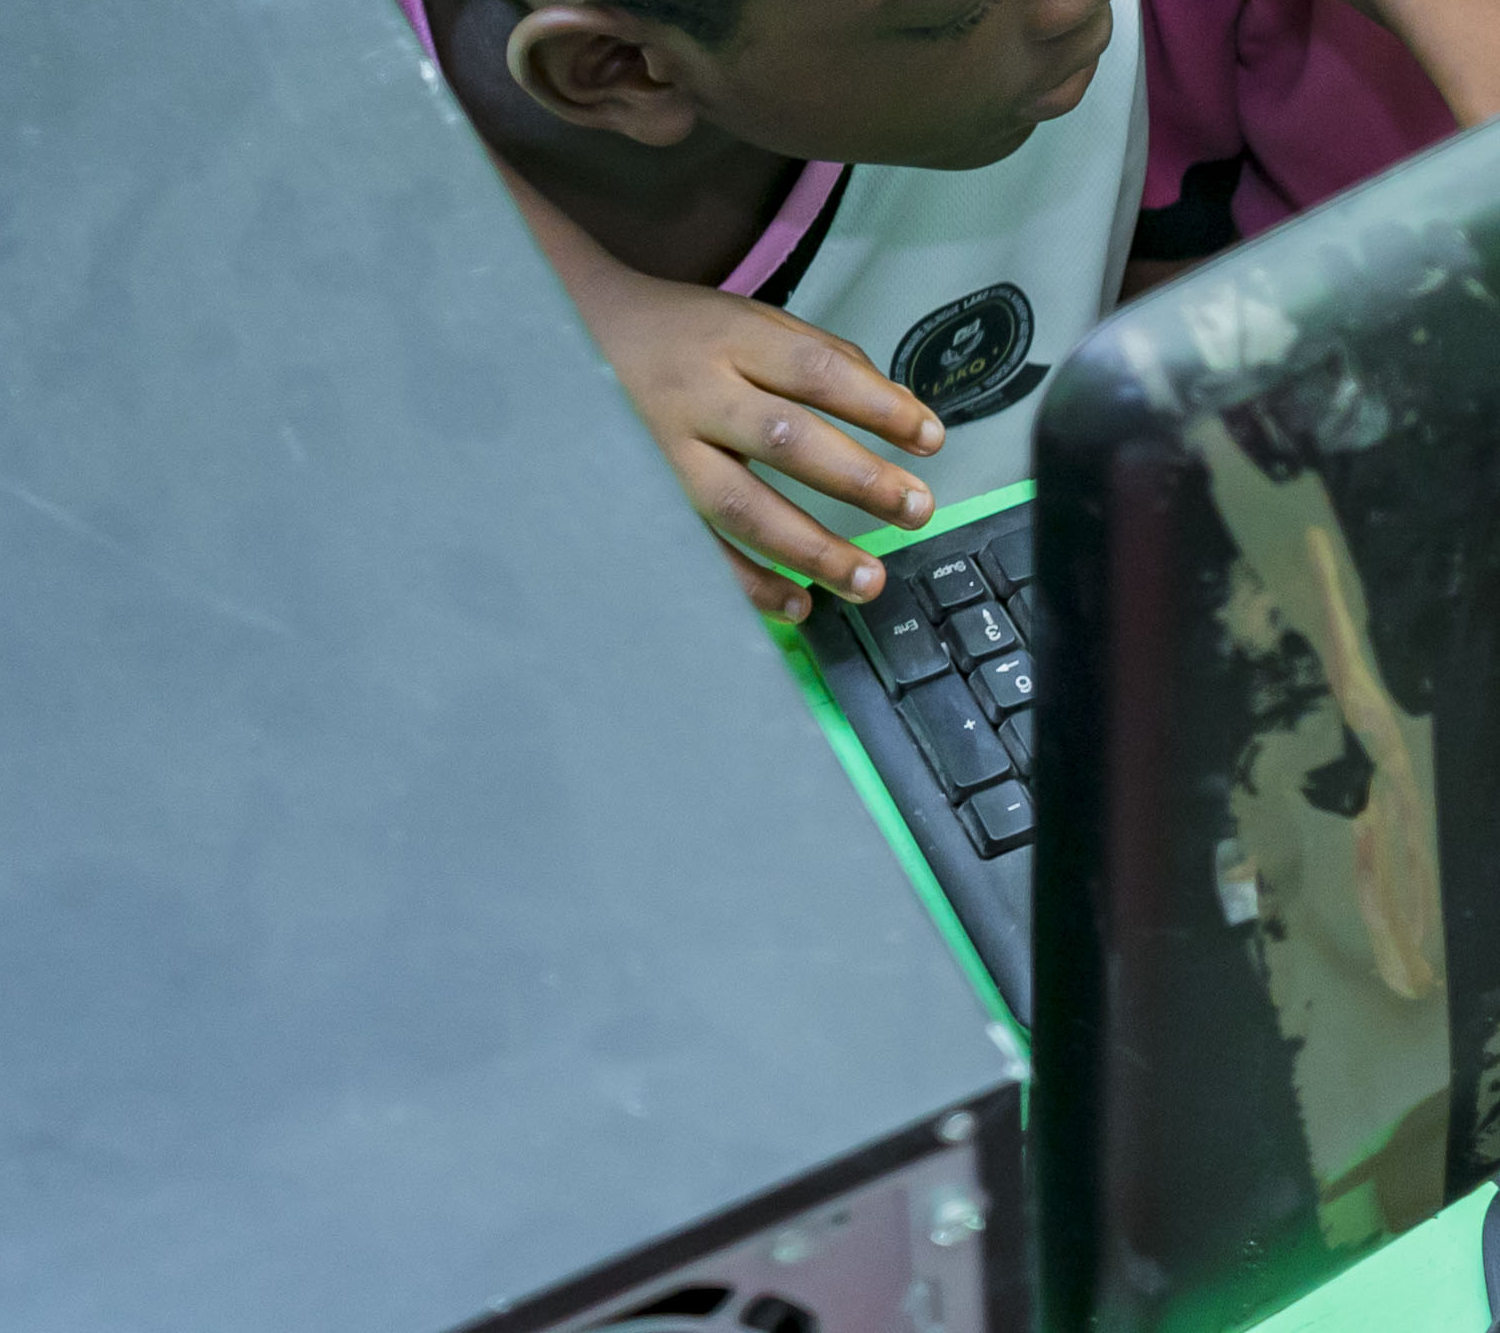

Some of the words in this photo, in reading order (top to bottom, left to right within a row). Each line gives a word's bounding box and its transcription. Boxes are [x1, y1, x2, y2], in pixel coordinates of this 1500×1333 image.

[932, 560, 967, 580] Suppr
[893, 618, 919, 635] Entr
[985, 624, 1001, 641] 3
[1015, 675, 1032, 693] 6
